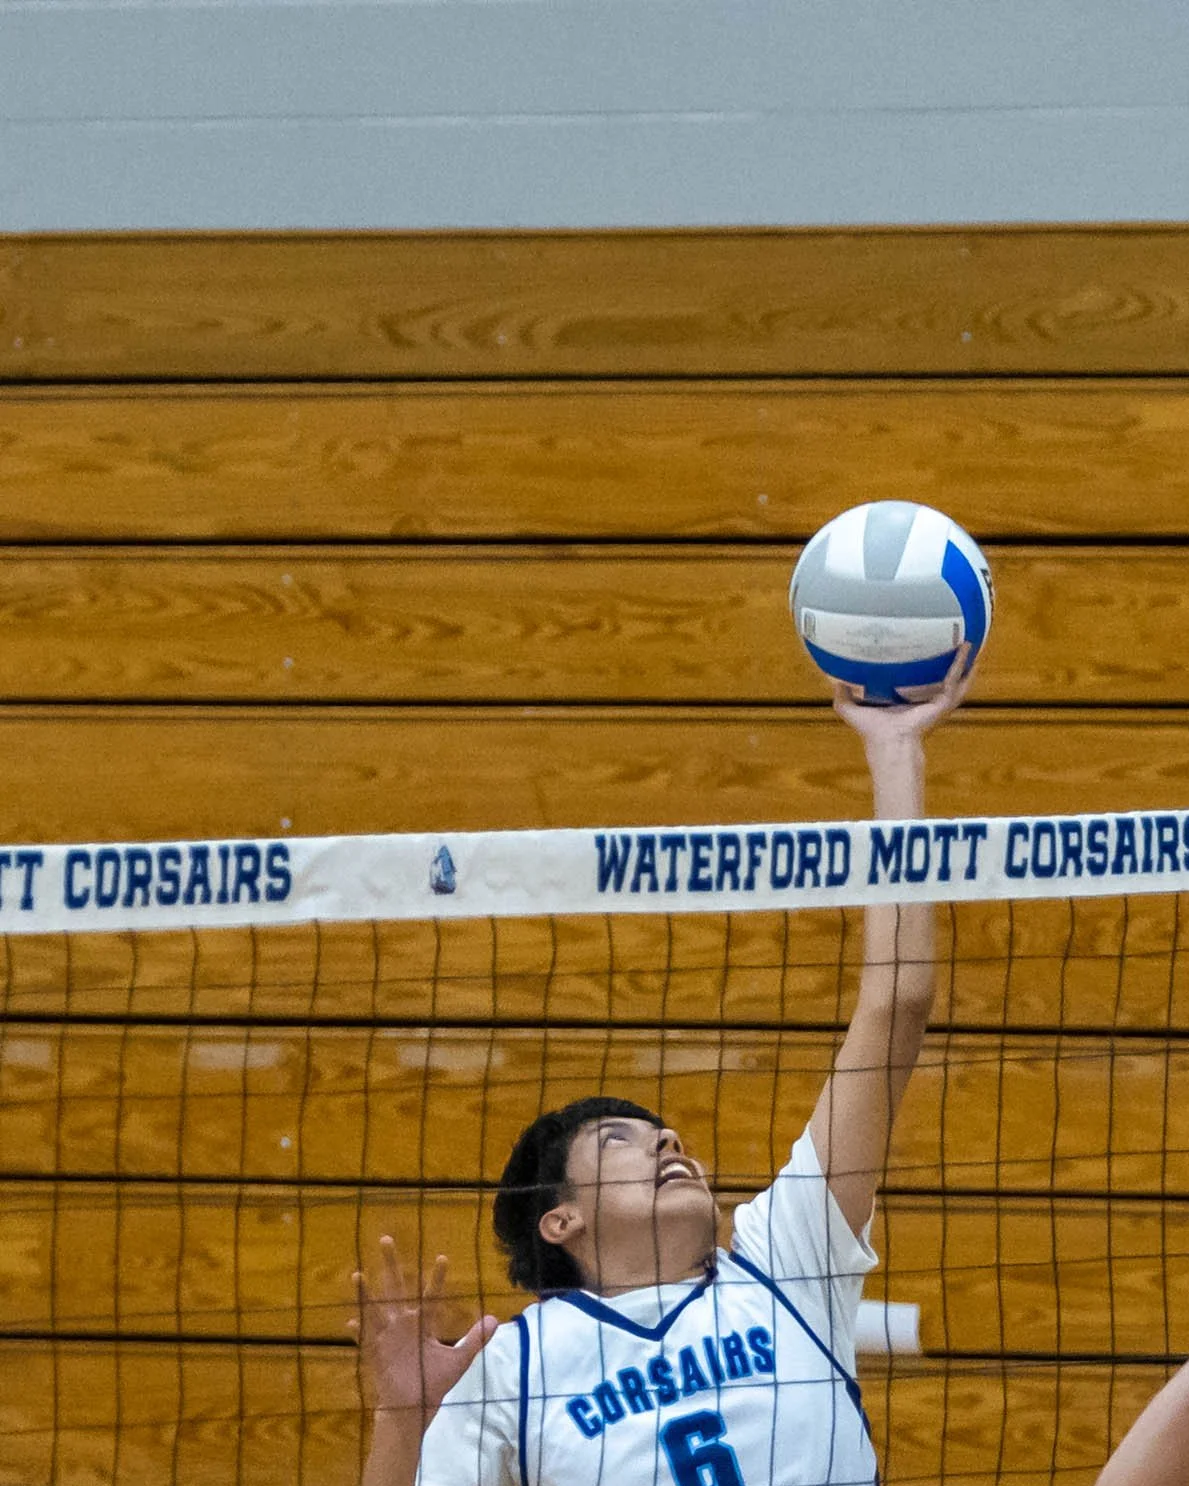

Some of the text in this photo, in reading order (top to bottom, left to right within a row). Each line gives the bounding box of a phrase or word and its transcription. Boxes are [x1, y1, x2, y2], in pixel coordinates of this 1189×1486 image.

[64, 843, 292, 910] CORSAIRS
[595, 829, 851, 894] WATERFORD
[868, 822, 988, 885] MOTT
[565, 1326, 776, 1439] CORSAIRS
